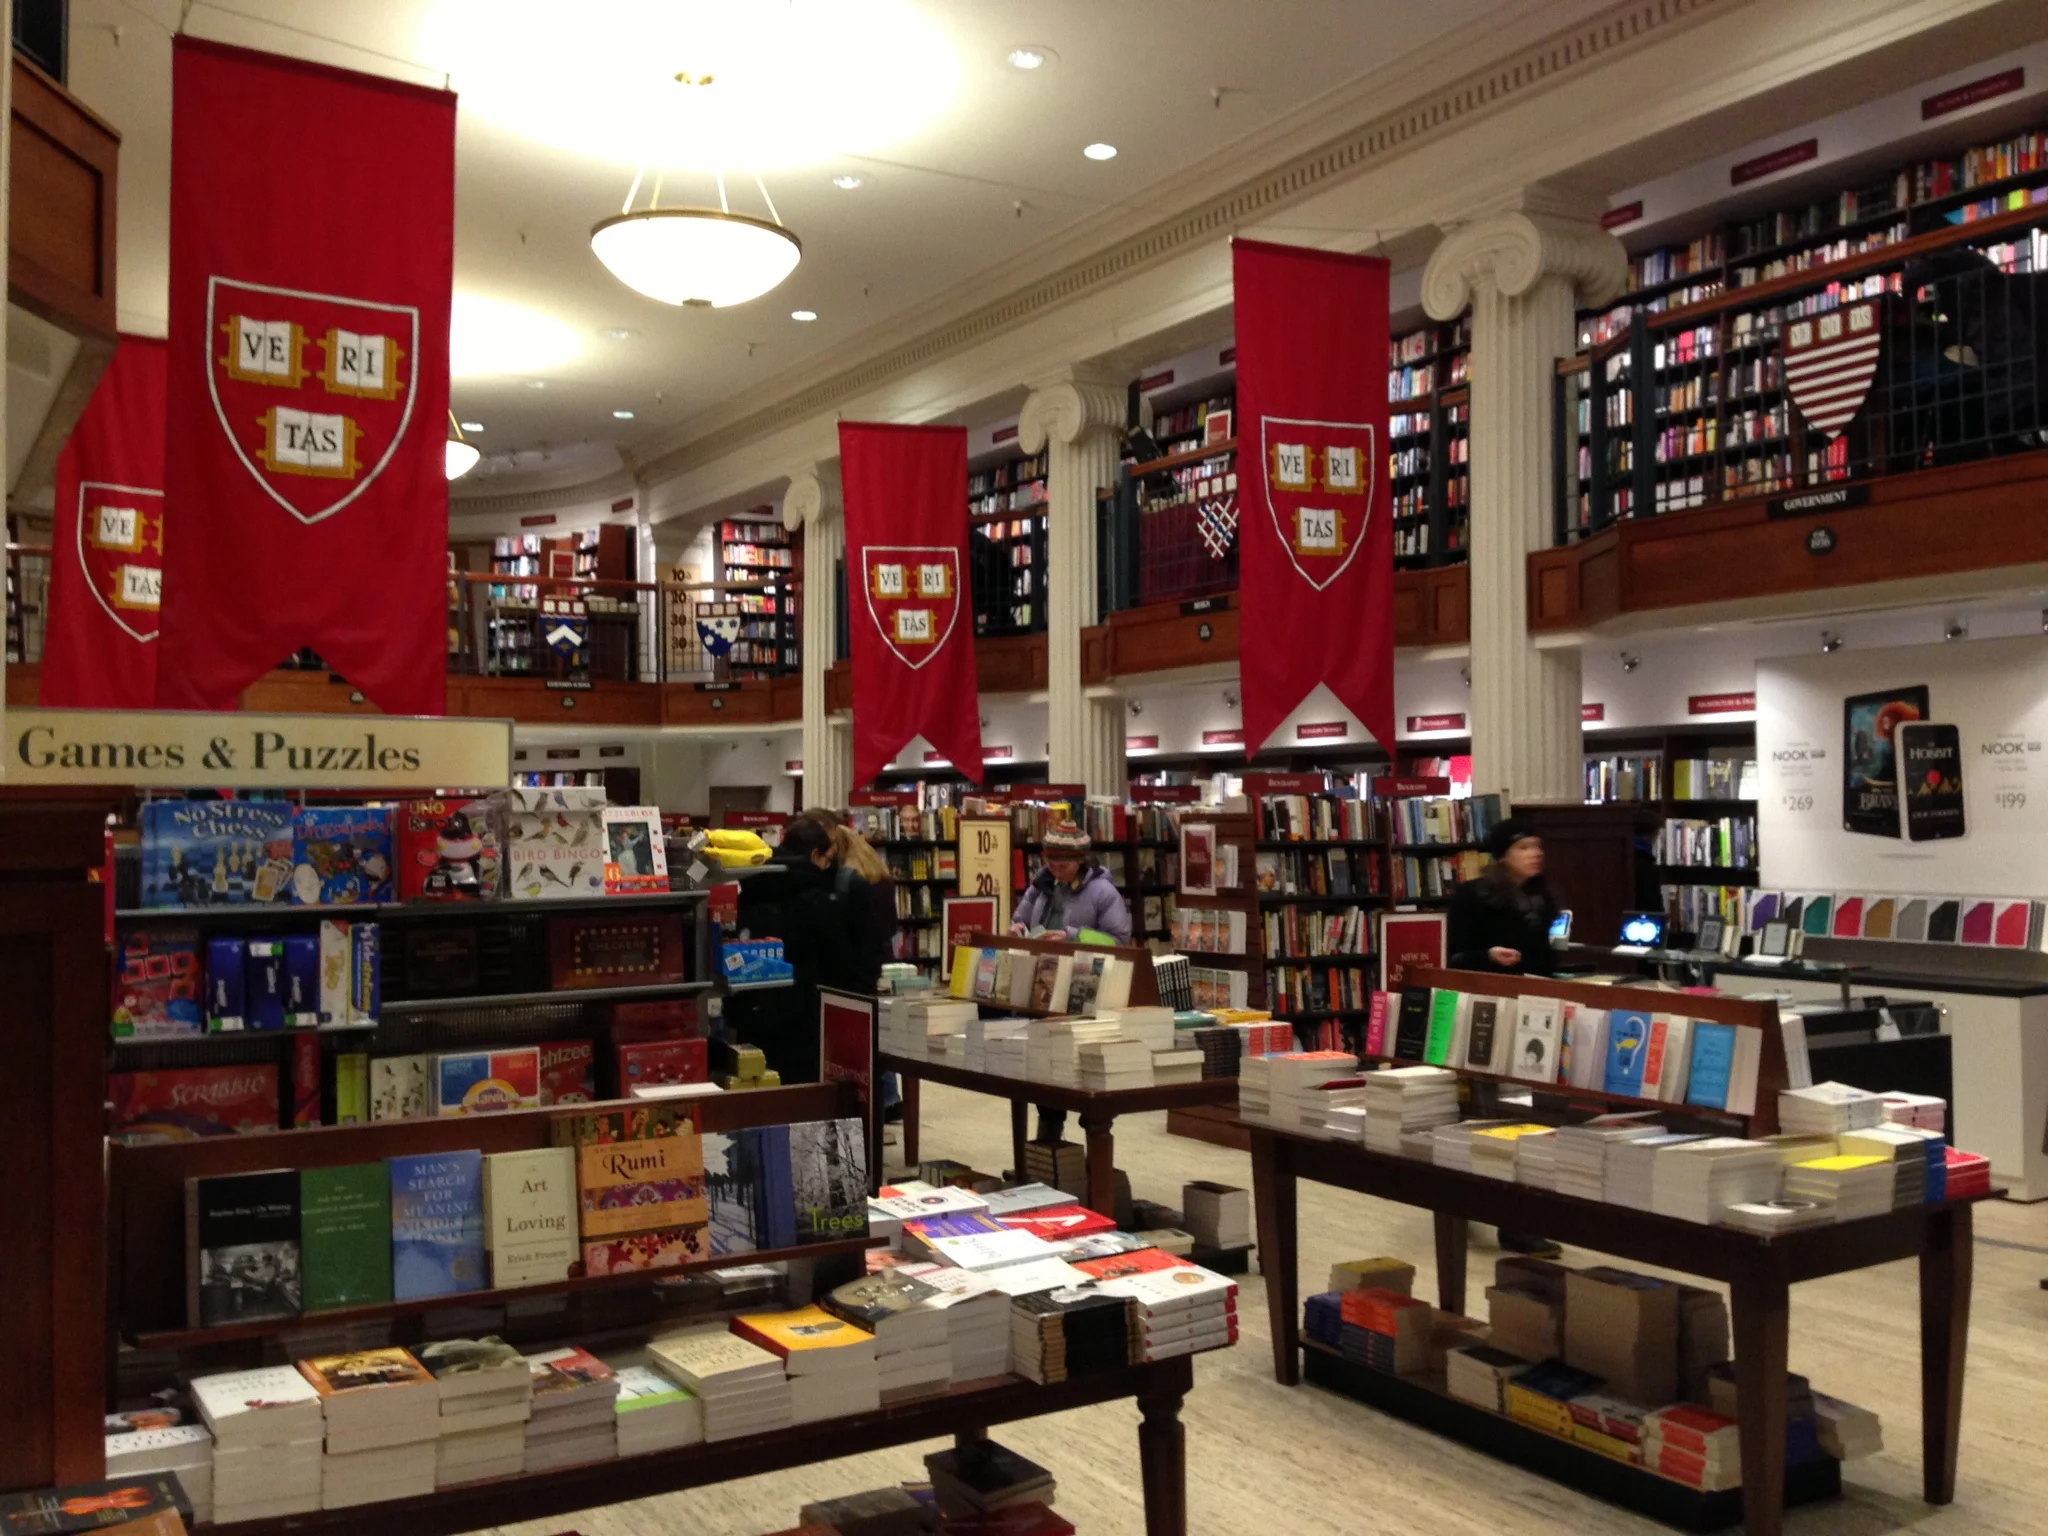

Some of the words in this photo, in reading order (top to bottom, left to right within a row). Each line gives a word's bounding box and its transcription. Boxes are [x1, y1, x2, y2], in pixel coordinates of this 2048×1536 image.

[244, 332, 285, 362] VE
[341, 346, 375, 375] RI
[285, 423, 337, 452] TAS
[1281, 455, 1303, 474] VE
[1331, 458, 1351, 476] RI
[103, 516, 132, 537] VE
[1305, 519, 1333, 538] TAS
[128, 575, 161, 596] TAS
[672, 568, 685, 582] 10
[881, 572, 900, 587] VE
[924, 573, 941, 587] RI
[902, 617, 927, 632] TAS
[17, 726, 185, 770] Games
[201, 736, 236, 770] &
[249, 730, 421, 771] Puzzles
[1772, 749, 1809, 761] NOOK
[1981, 742, 2025, 755] NOOK
[173, 806, 206, 824] No
[206, 801, 285, 828] Stress
[409, 800, 446, 816] UNO
[192, 818, 266, 839] Chess
[977, 829, 992, 854] 10
[513, 850, 546, 861] BIRD
[553, 849, 600, 860] BINGO
[976, 872, 993, 896] 20
[1401, 952, 1419, 962] NEW
[1420, 951, 1430, 961] IN
[540, 1045, 591, 1069] ahtzee
[602, 1149, 666, 1180] Rumi
[521, 1181, 549, 1194] Art
[506, 1214, 567, 1233] Loving
[807, 1207, 864, 1232] Trees
